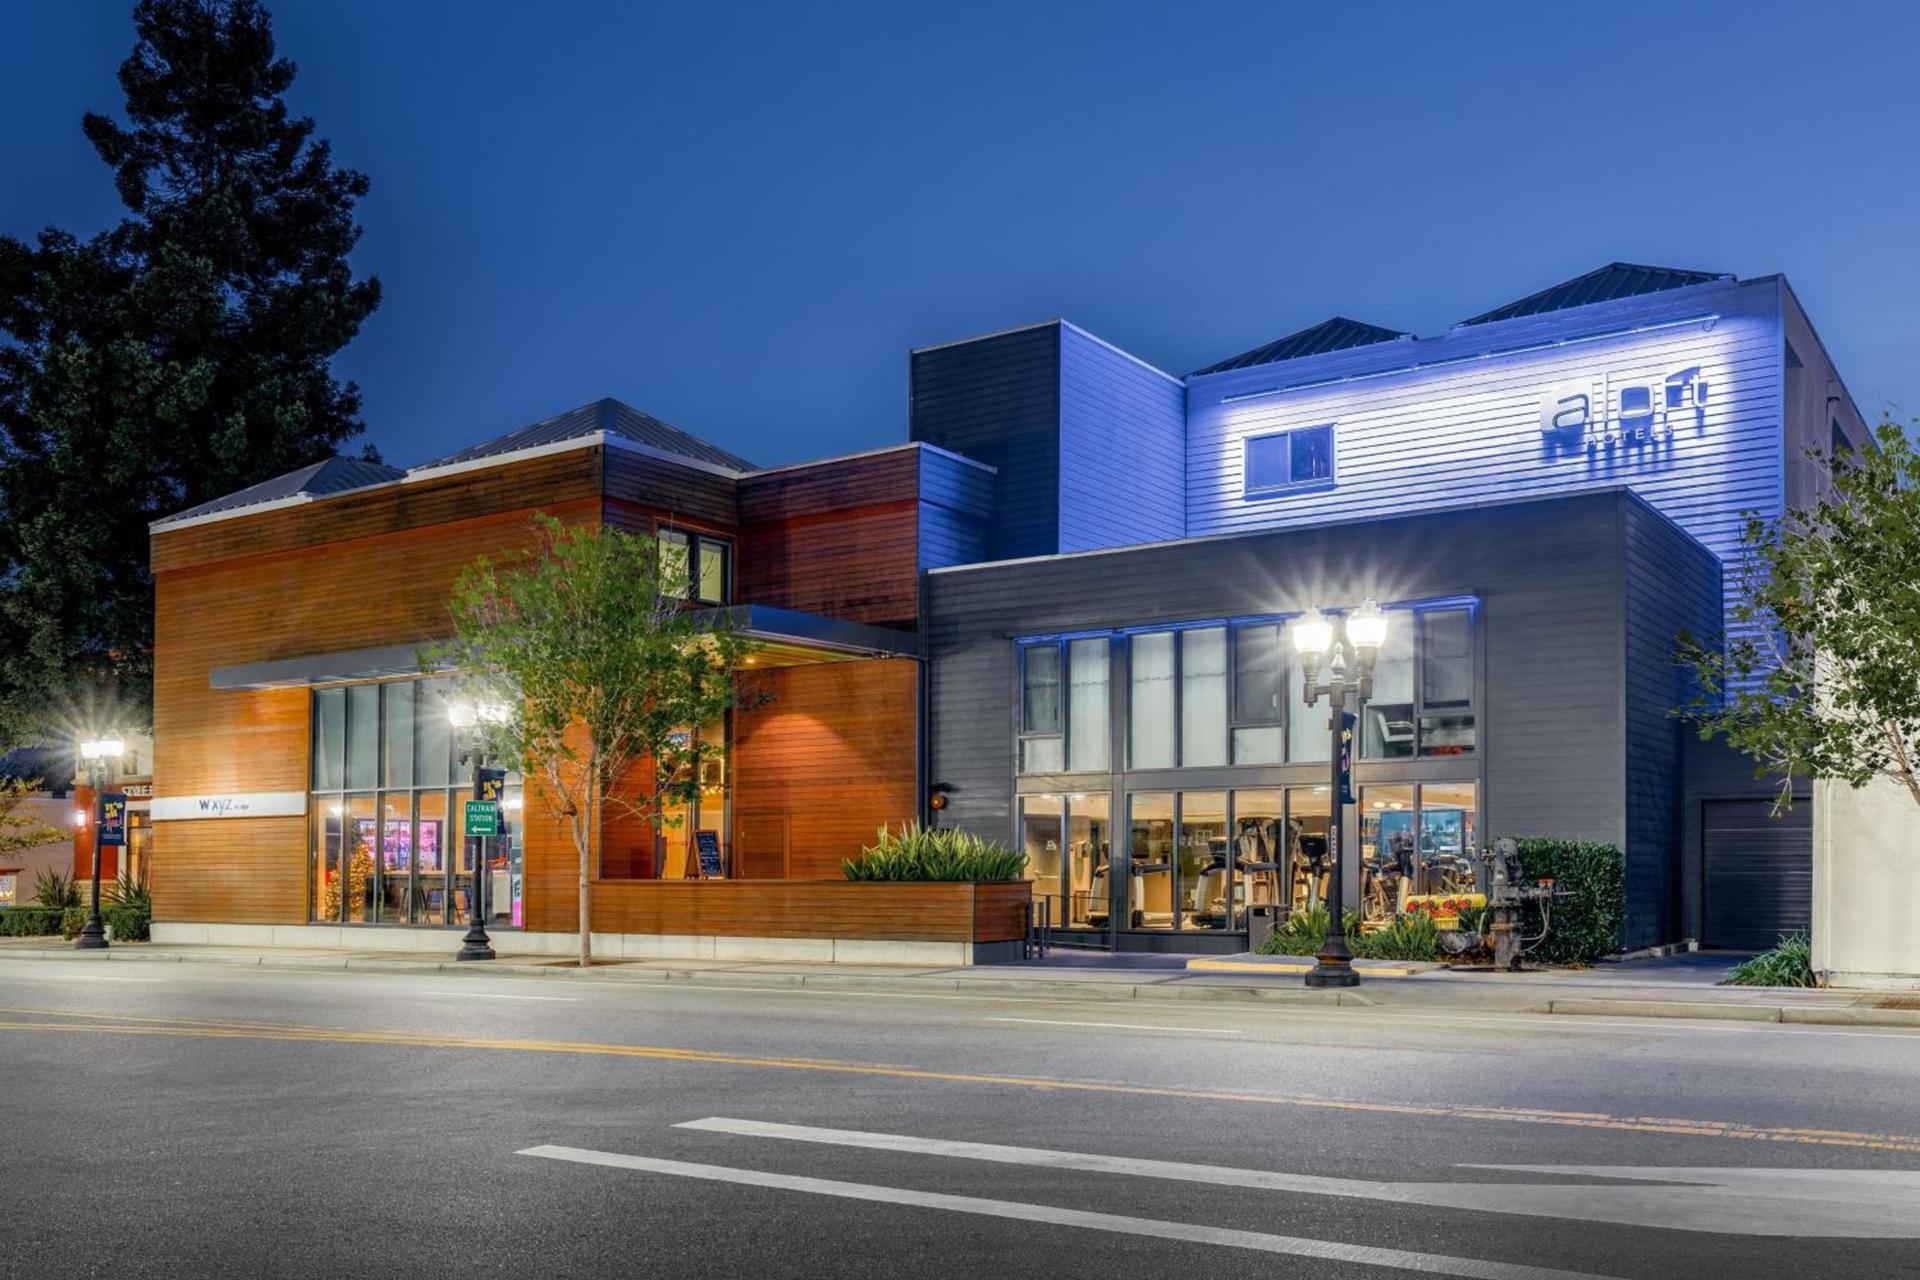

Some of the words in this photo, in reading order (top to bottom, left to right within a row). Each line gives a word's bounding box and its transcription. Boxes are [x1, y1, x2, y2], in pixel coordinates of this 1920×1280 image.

[1542, 366, 1708, 429] aloft
[1587, 425, 1675, 446] HOTELS
[467, 804, 497, 812] CALTRAIN
